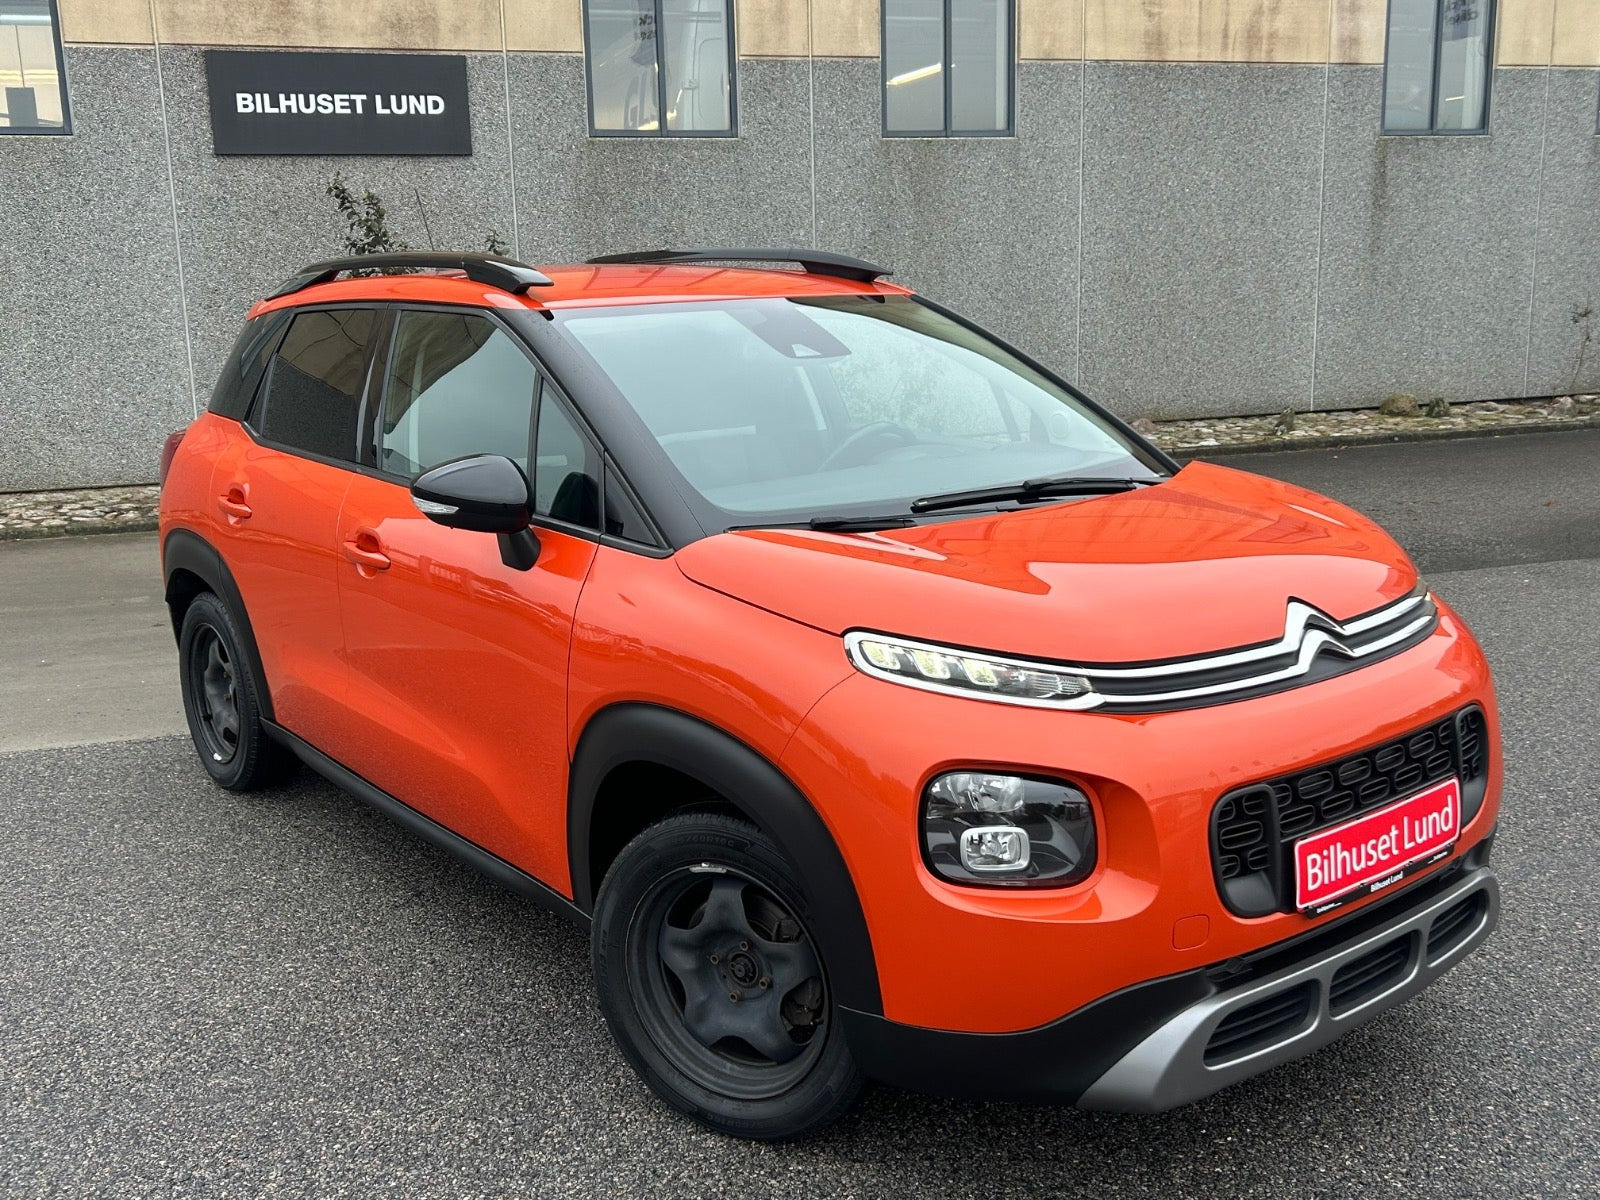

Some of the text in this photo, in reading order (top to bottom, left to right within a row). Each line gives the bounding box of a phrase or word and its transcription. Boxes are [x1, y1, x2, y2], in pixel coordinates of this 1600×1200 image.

[236, 92, 445, 115] BILHUSET LUND
[1306, 794, 1453, 892] Bilhuset Lund
[1370, 871, 1403, 893] Bilhuset Lund
